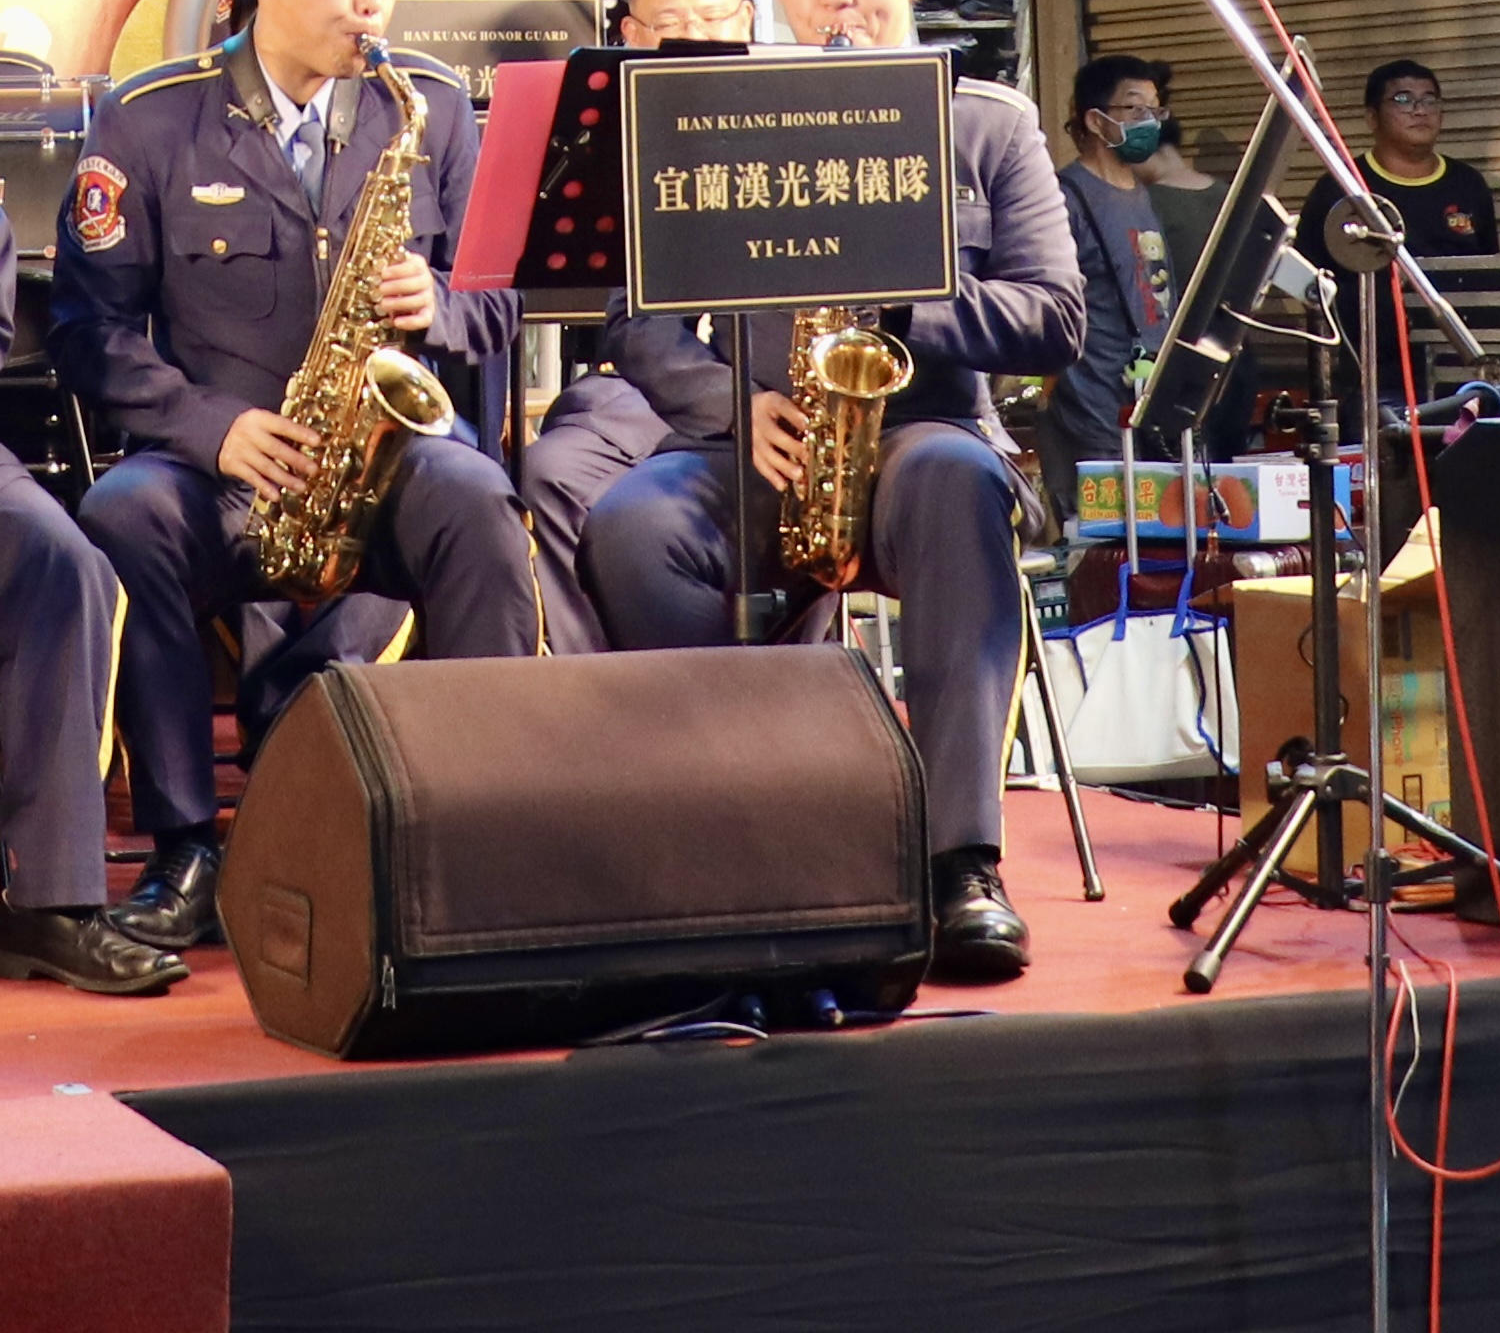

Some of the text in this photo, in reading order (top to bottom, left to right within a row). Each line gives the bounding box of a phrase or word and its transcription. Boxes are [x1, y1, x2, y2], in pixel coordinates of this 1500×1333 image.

[403, 30, 569, 41] HAN KUANG HONOR GUARD
[677, 108, 901, 131] HAN KUANG HONOR GUARD
[653, 154, 930, 212] 宜蘭漢光樂儀隊
[746, 236, 841, 259] YI-LAN
[1081, 477, 1156, 506] 台灣果
